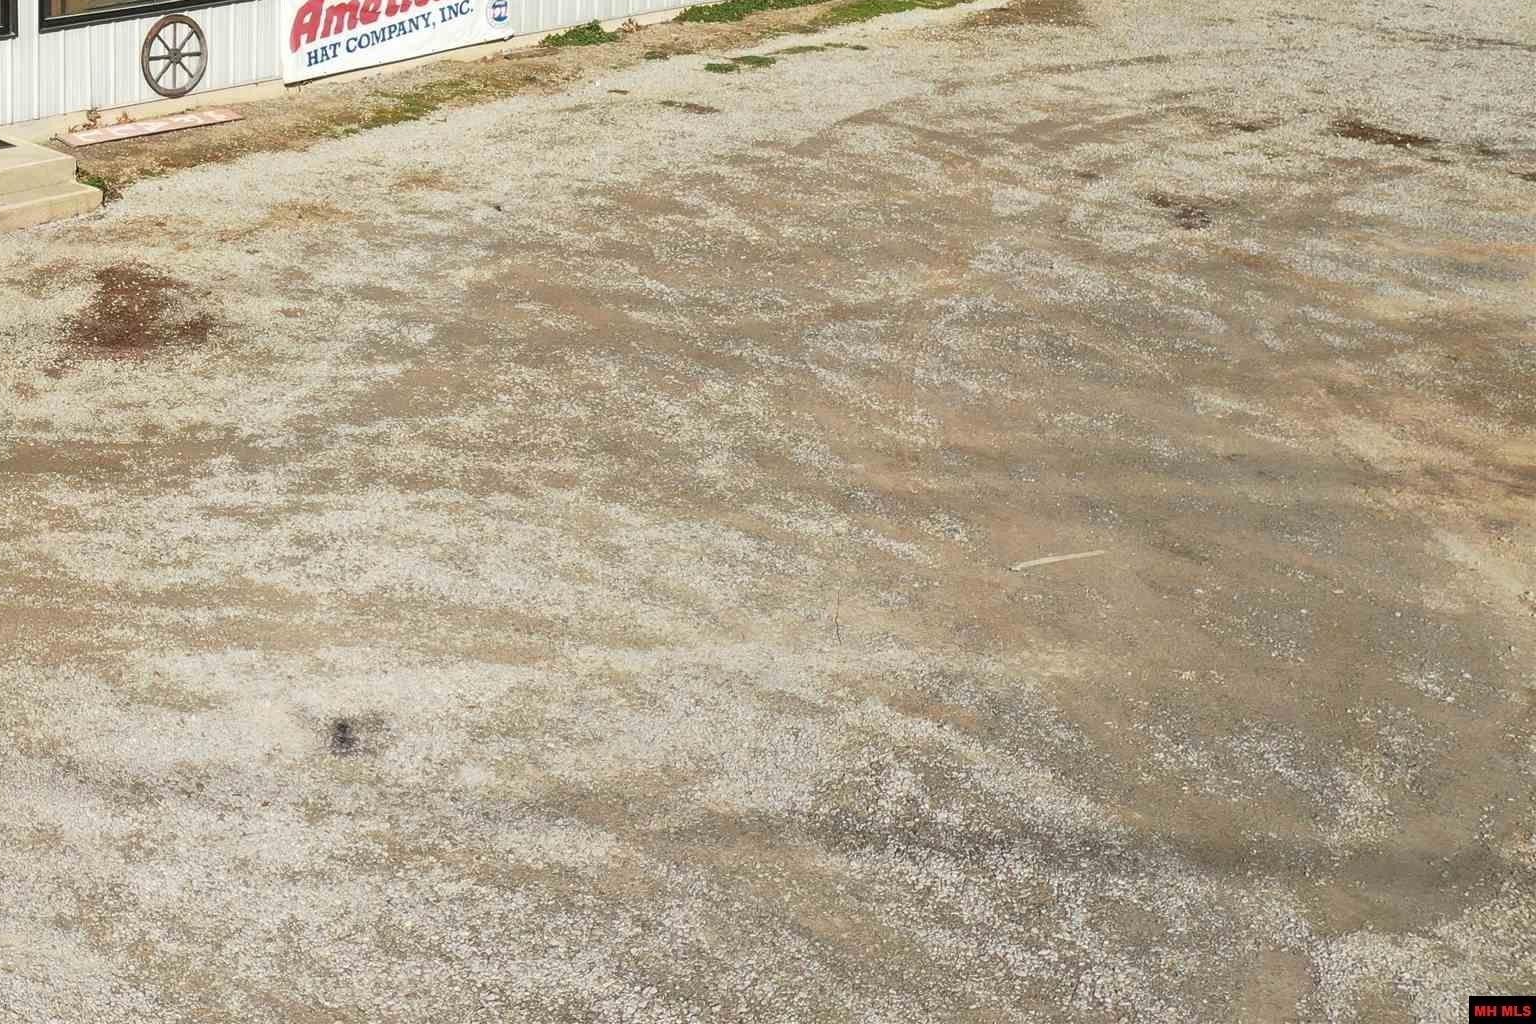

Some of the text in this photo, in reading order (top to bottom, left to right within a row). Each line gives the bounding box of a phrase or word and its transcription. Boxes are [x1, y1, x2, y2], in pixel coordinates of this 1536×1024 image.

[306, 41, 341, 67] HAT
[345, 10, 436, 54] COMPANY,
[440, 0, 474, 24] INC.
